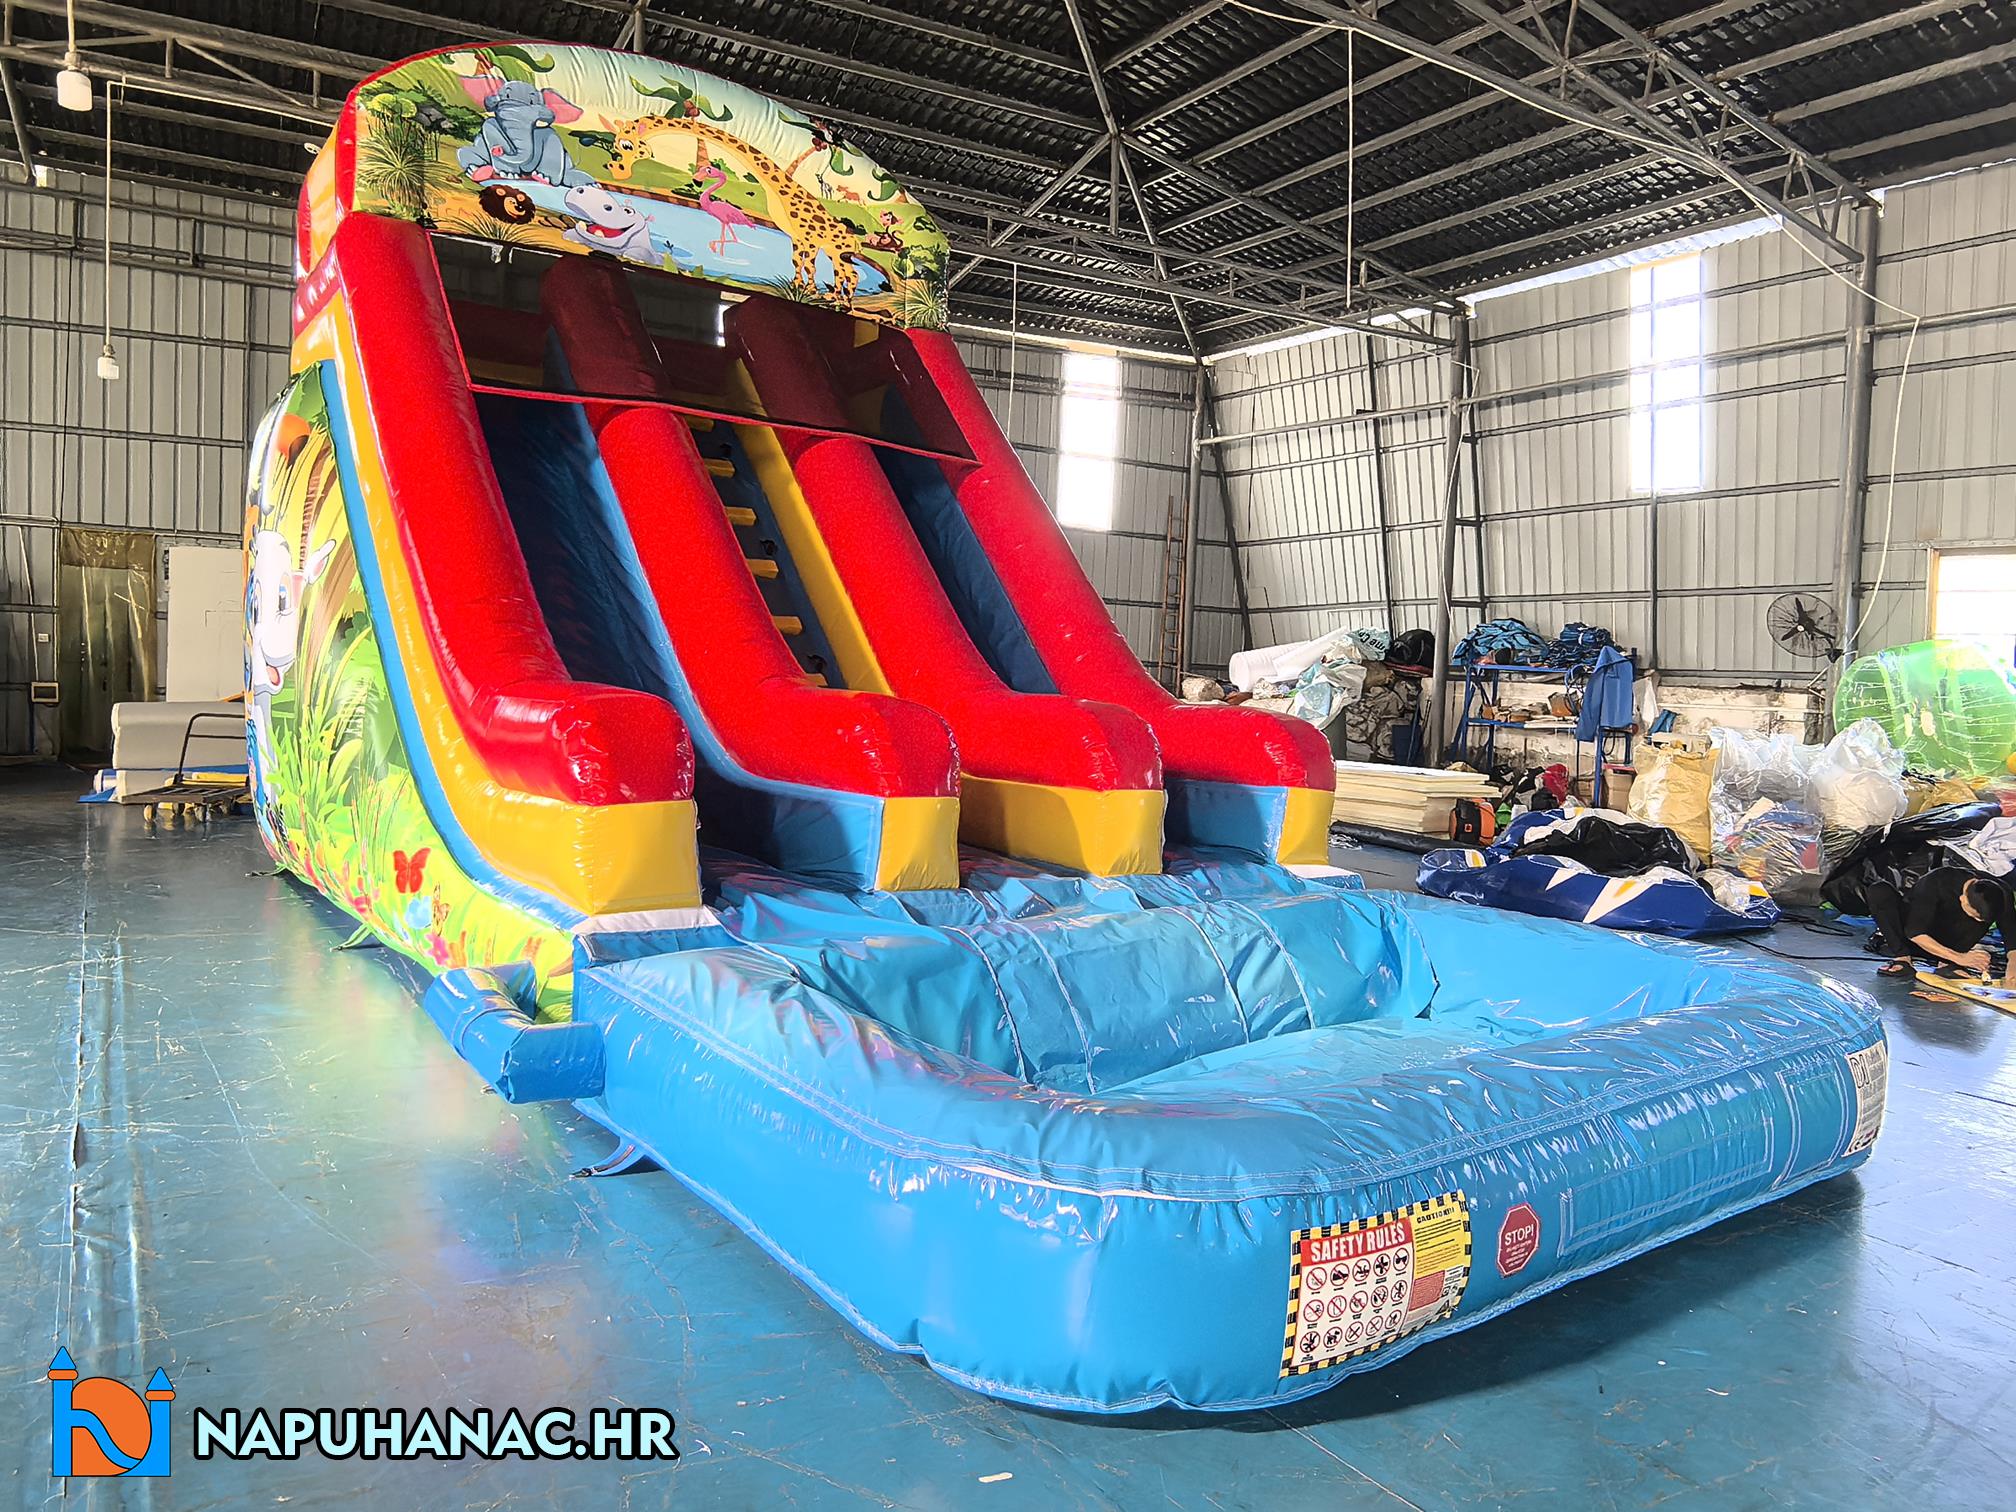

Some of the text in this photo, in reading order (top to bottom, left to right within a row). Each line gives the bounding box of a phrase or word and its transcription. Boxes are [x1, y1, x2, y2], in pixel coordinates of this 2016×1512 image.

[1310, 1232, 1365, 1262] SAFETY
[1366, 1222, 1405, 1252] RULES
[1504, 1223, 1534, 1246] STOP!
